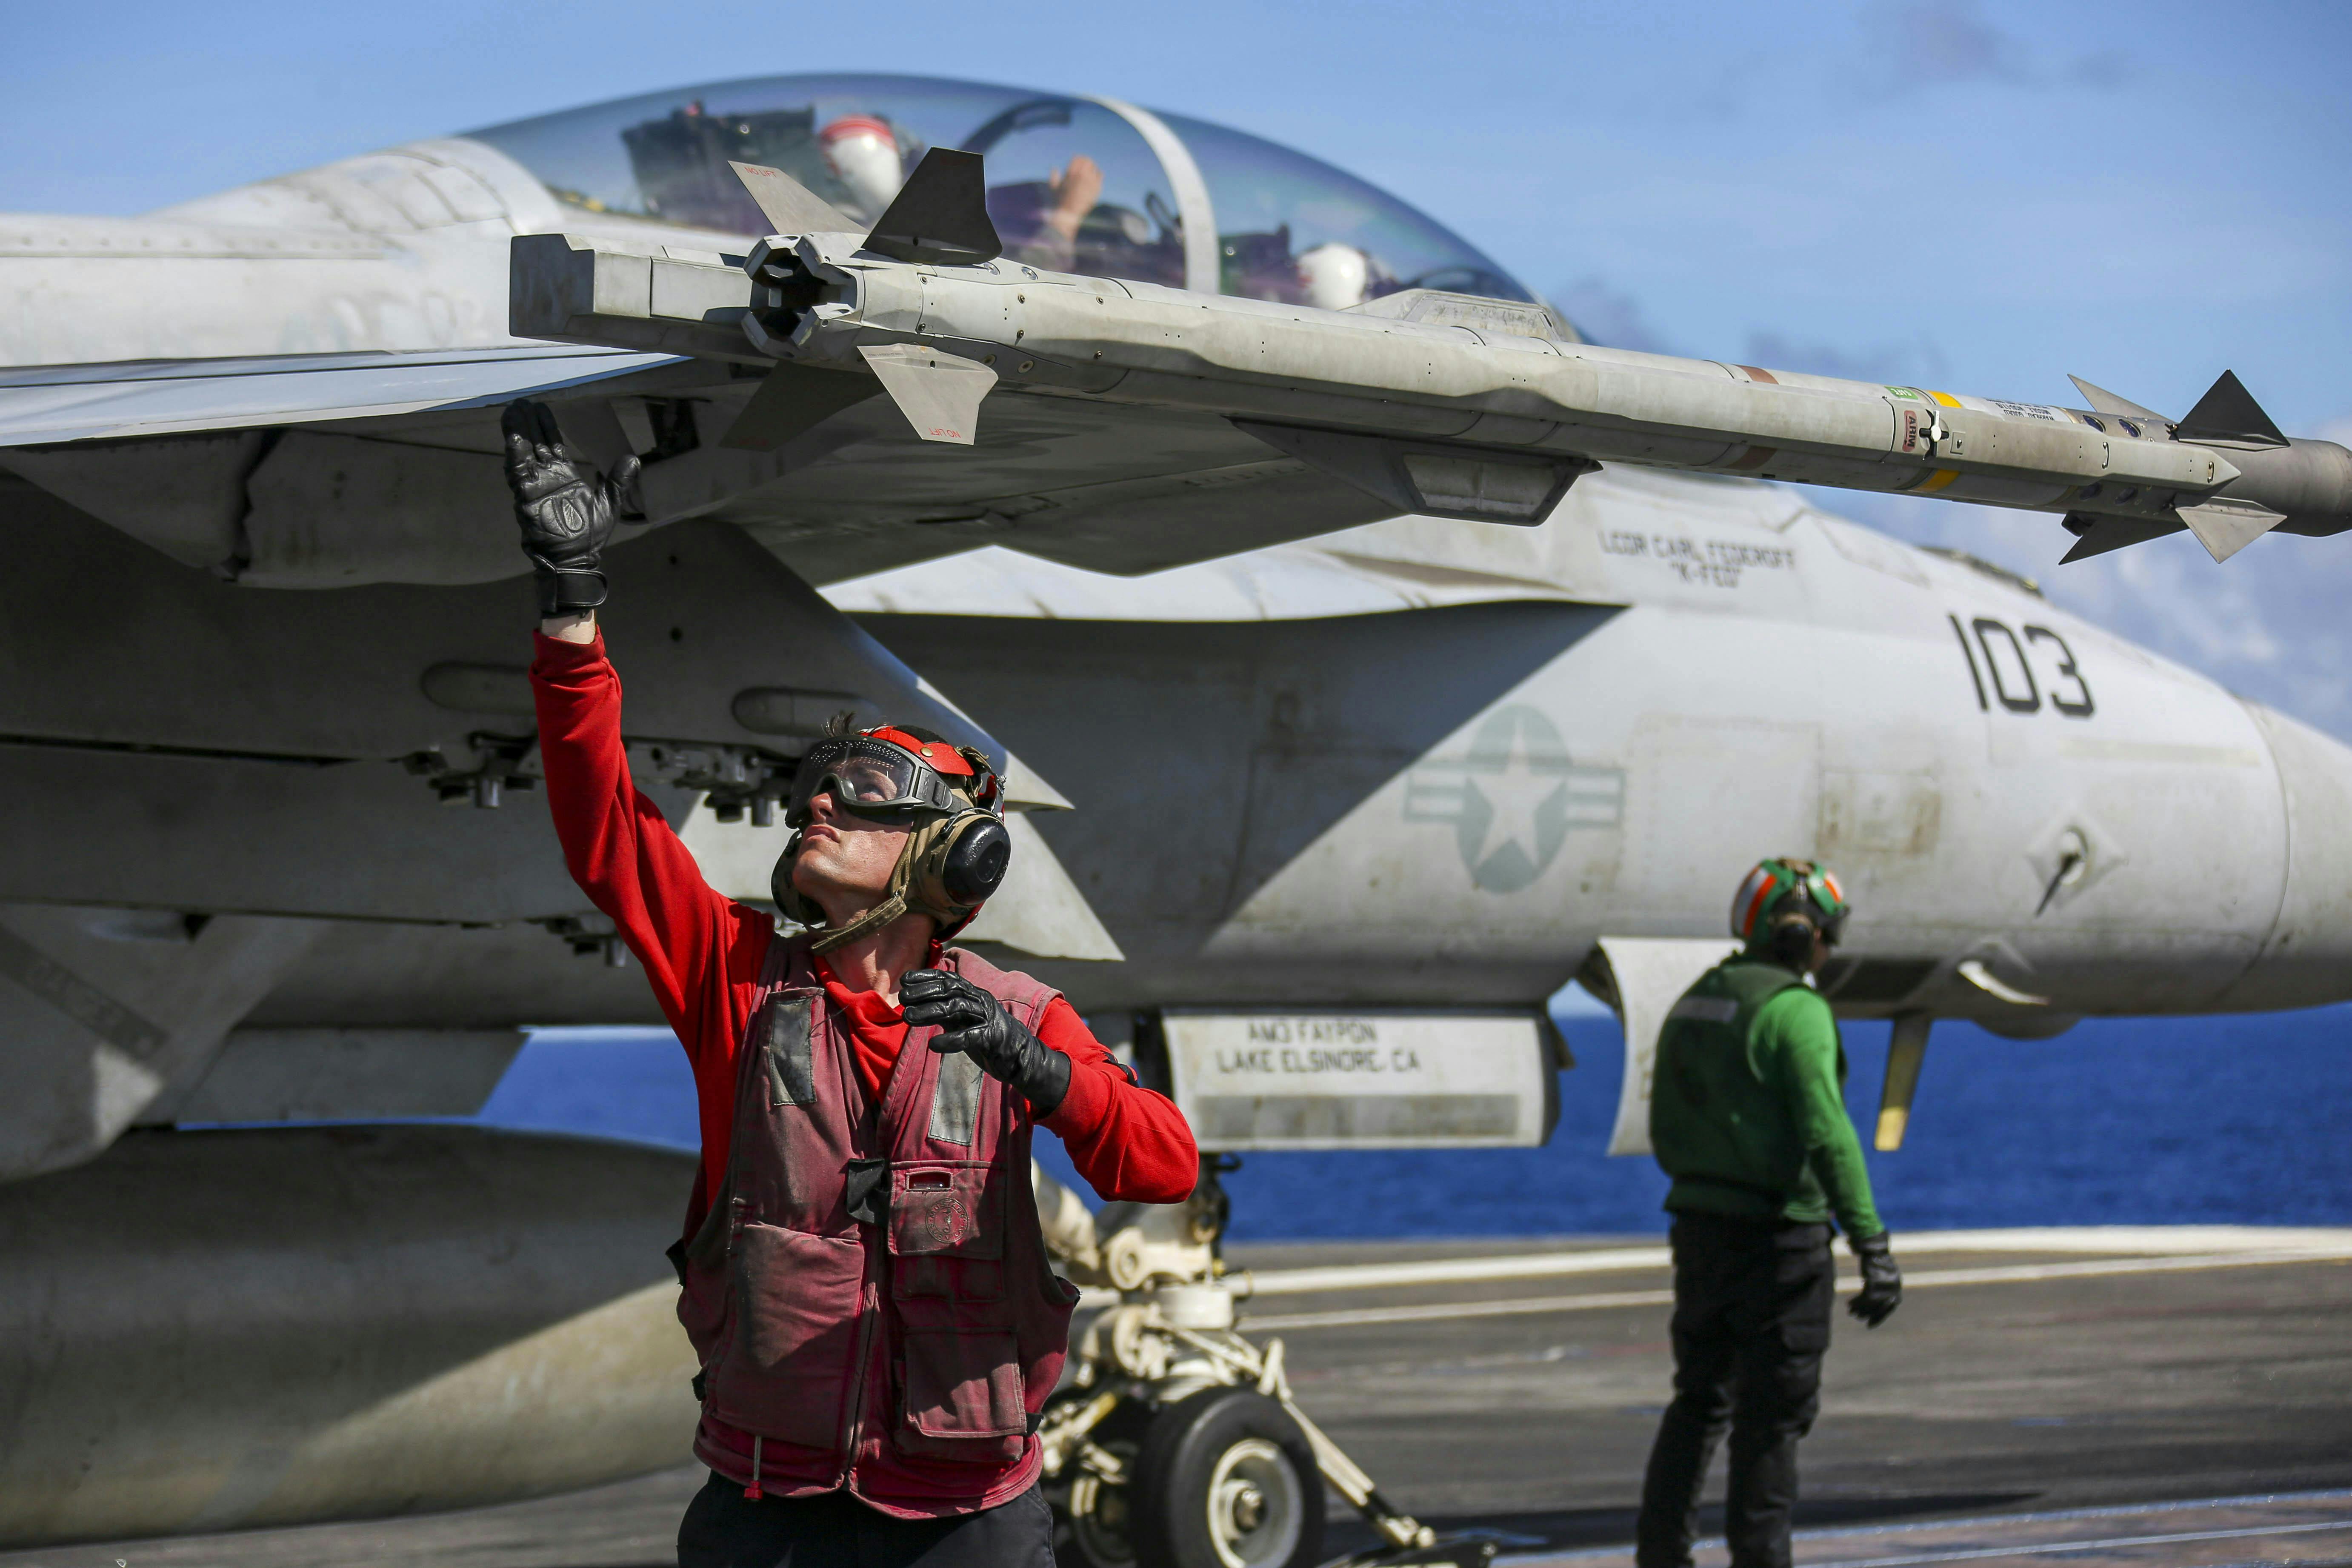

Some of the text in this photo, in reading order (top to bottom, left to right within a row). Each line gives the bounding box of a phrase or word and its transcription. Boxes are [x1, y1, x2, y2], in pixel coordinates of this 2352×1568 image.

[743, 166, 777, 178] NO LIFT
[1890, 388, 1912, 397] SAFE
[929, 428, 961, 438] NO LIFT
[1907, 416, 1916, 448] ARM
[1597, 531, 1648, 555] LCDR
[1947, 614, 2095, 717] 103
[1216, 1049, 1274, 1073] LAKE
[1393, 1049, 1421, 1071] CA
